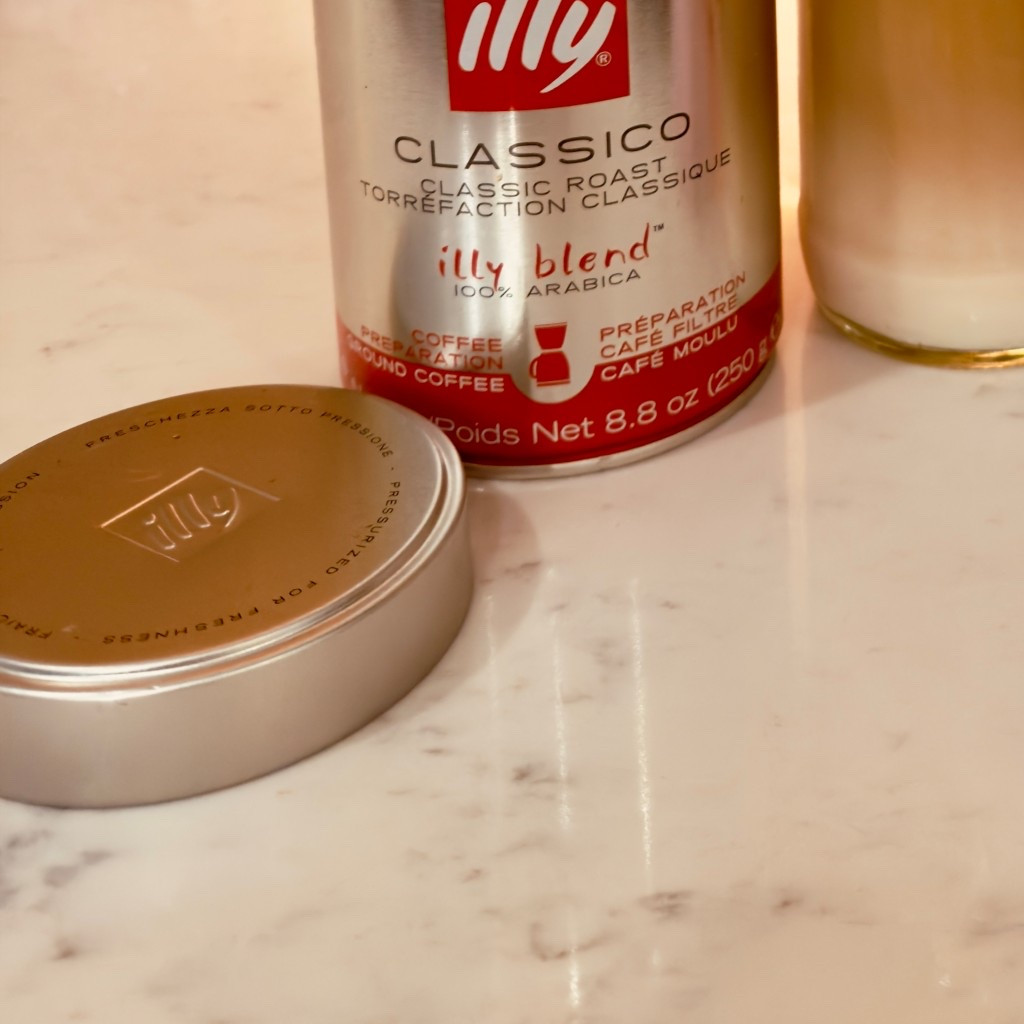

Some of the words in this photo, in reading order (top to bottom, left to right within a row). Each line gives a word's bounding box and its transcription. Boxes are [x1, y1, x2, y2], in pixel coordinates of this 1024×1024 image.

[394, 112, 691, 170] CLASSICO
[360, 179, 566, 218] TORRÉFACTION
[581, 147, 731, 210] CLASSIQUE
[420, 178, 551, 199] CLASSIC
[566, 156, 667, 193] ROAST
[438, 245, 504, 292] illy
[454, 284, 513, 299] 100%
[526, 268, 641, 298] ARABICA
[600, 271, 746, 342] PRÉPARATION
[600, 329, 663, 359] CAFÉ
[673, 293, 738, 339] FILTRE
[360, 324, 504, 371] PREPARATION
[410, 328, 503, 353] COFFEE
[601, 350, 664, 382] CAFÉ
[673, 314, 738, 360] MOULU
[414, 368, 505, 393] COFFEE
[532, 417, 595, 445] Net
[605, 400, 658, 434] 8.8
[666, 387, 700, 415] oz
[707, 347, 755, 397] (250
[85, 406, 231, 449] FRESCHEZZA
[245, 404, 313, 416] SOTTO
[319, 411, 395, 458] PRESSIONE
[142, 487, 241, 551] illy
[325, 481, 401, 575] PRESSURIZED
[272, 580, 318, 605] FOR
[102, 607, 260, 645] FRESHNESS
